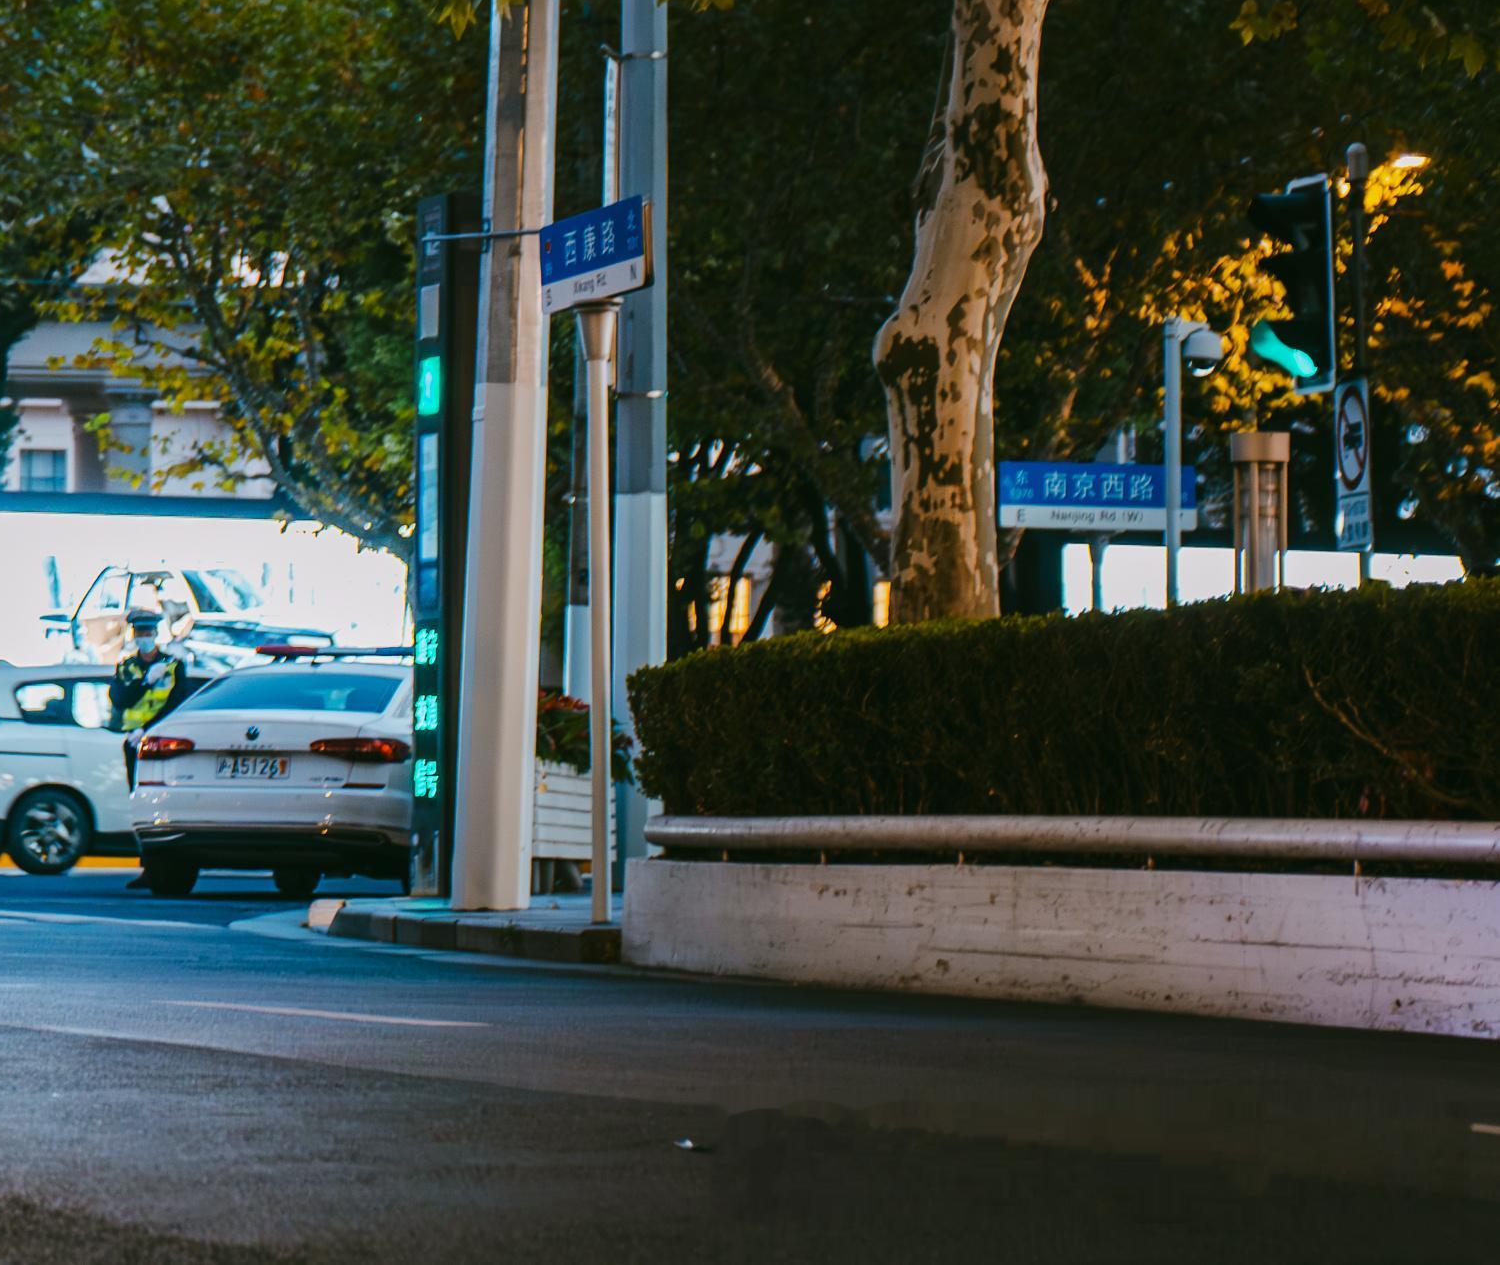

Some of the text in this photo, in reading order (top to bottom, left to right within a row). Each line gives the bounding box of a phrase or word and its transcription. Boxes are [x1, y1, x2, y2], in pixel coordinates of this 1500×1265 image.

[563, 219, 616, 266] 西康路
[1044, 470, 1154, 500] 南京西路
[1017, 509, 1144, 525] E Nanjing Rd (W)
